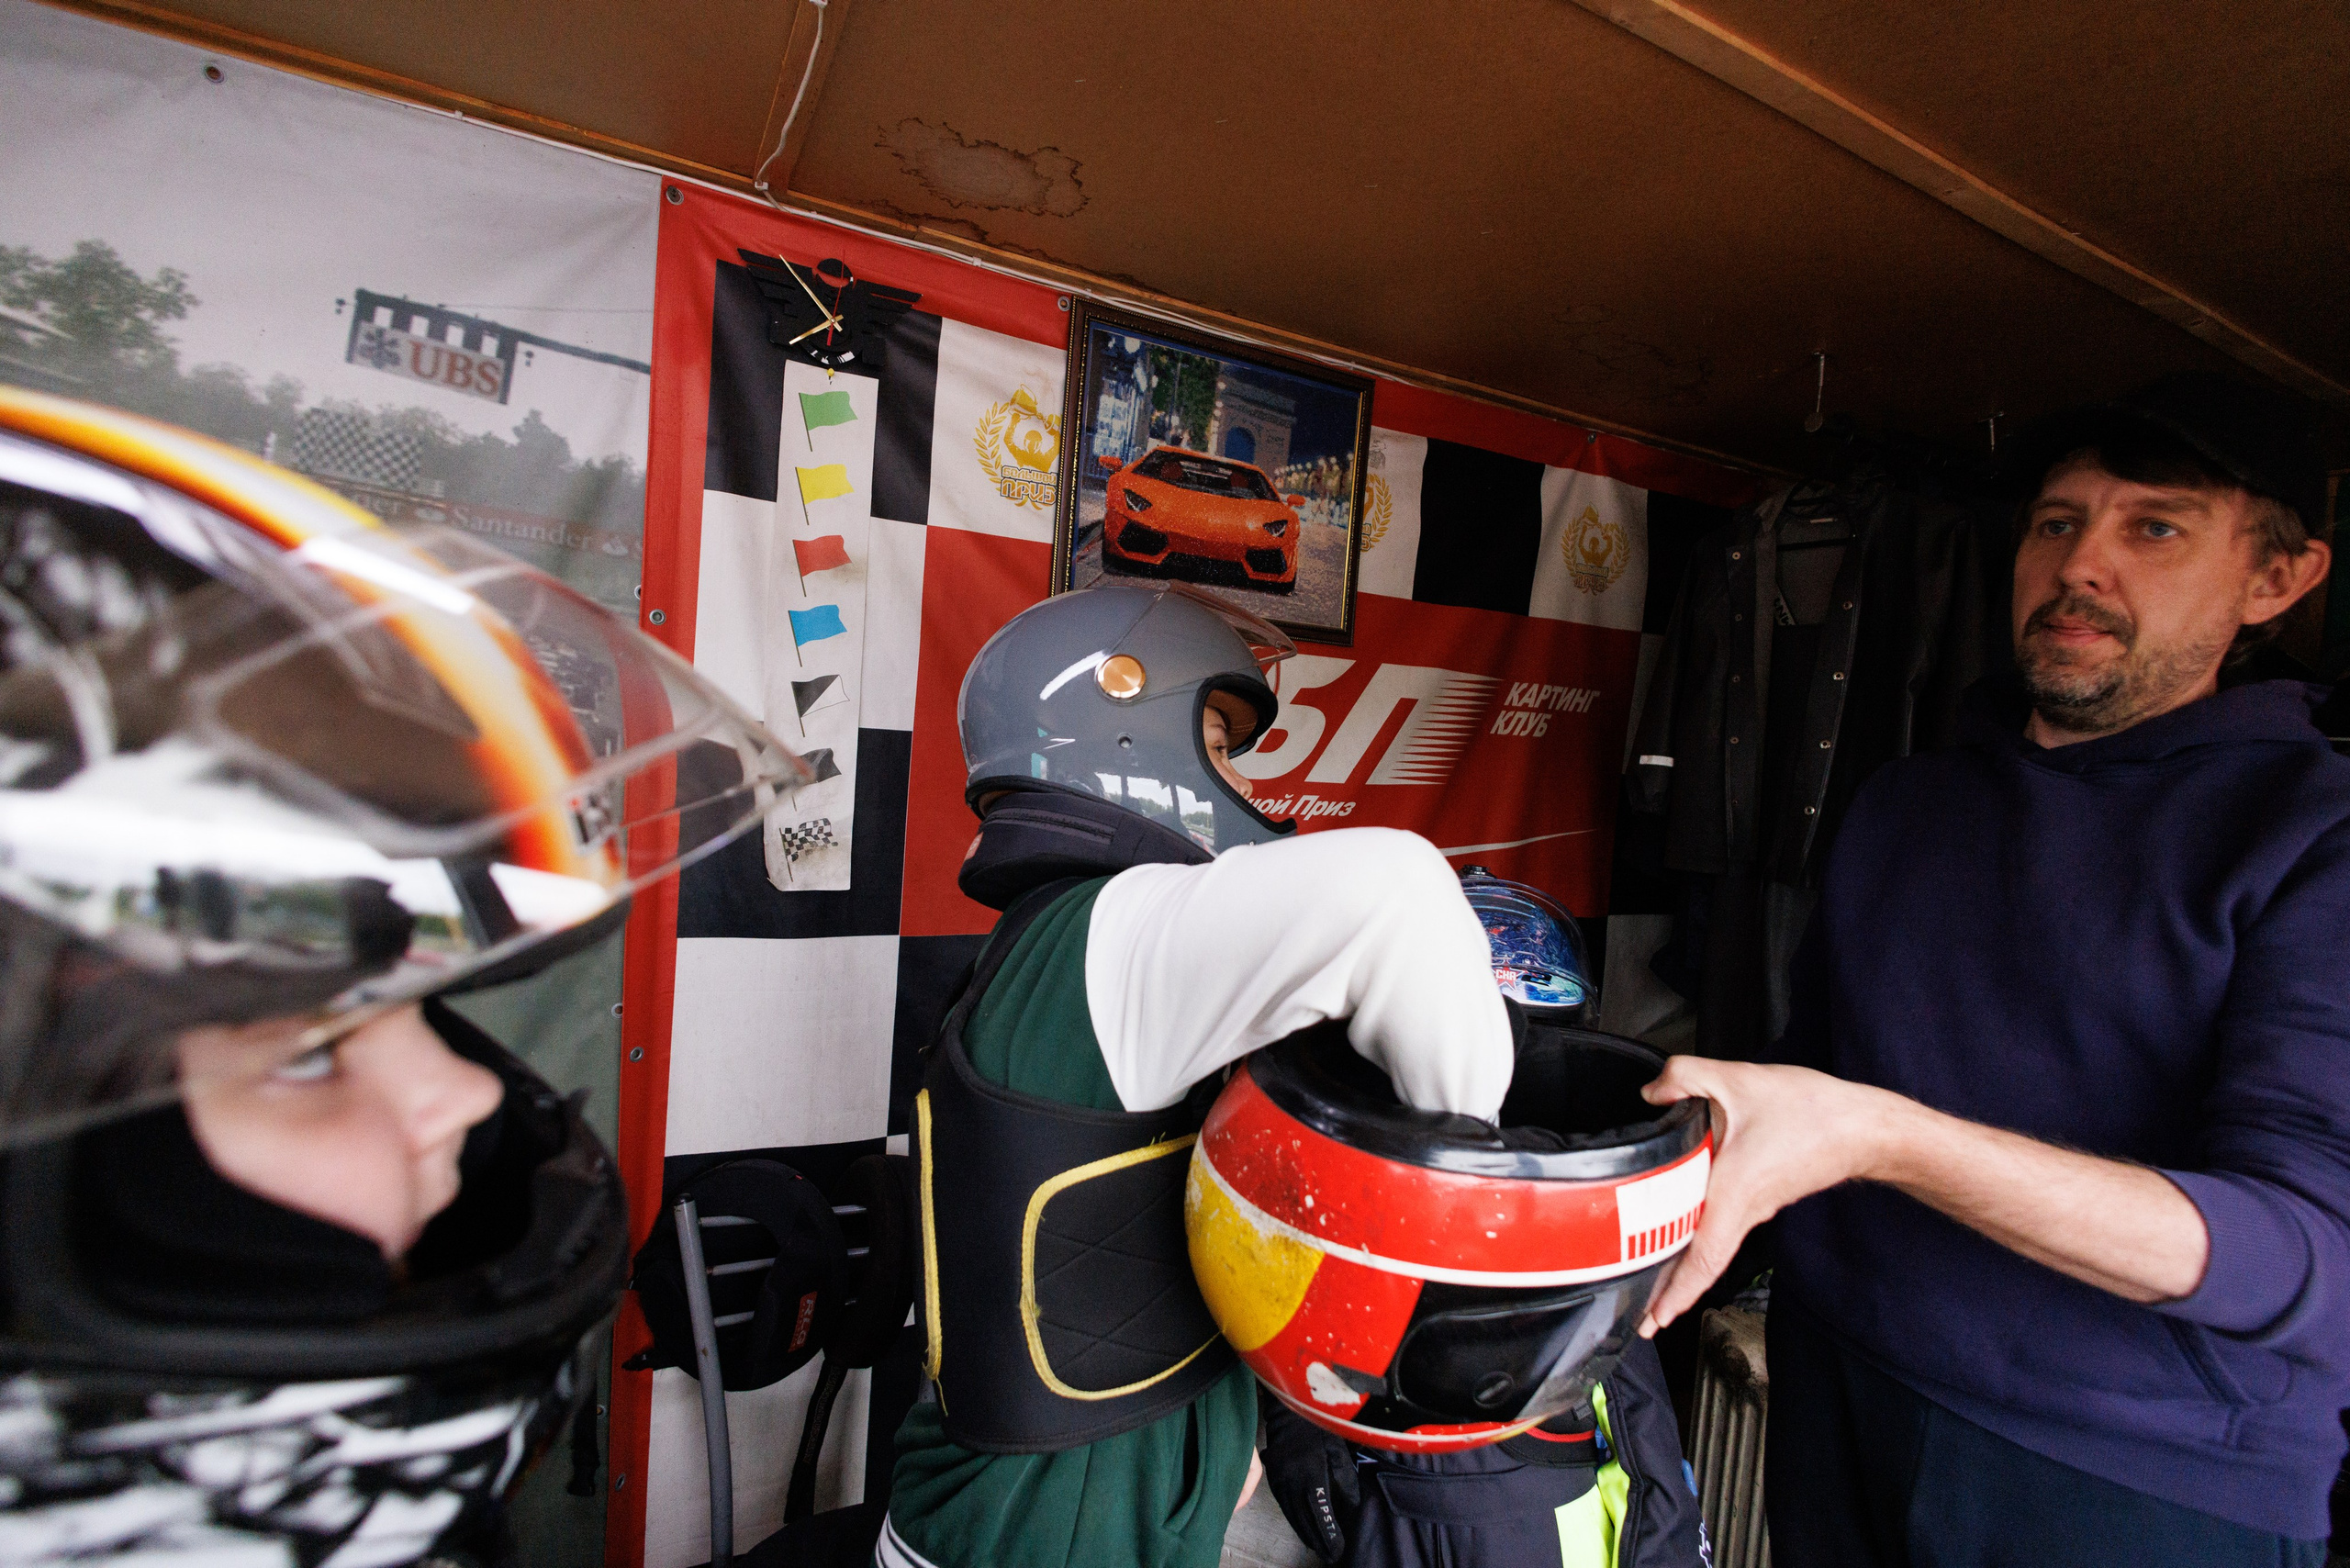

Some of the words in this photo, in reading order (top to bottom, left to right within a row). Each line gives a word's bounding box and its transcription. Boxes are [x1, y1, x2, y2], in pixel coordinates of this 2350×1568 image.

[408, 339, 499, 397] UBS
[1001, 477, 1057, 504] ПРИЗ
[453, 506, 590, 551] Santander
[1504, 681, 1600, 713] КАРТИНГ
[1489, 711, 1552, 738] КЛУБ
[1289, 795, 1357, 821] Приз
[1315, 1487, 1337, 1540] KIPSTA
